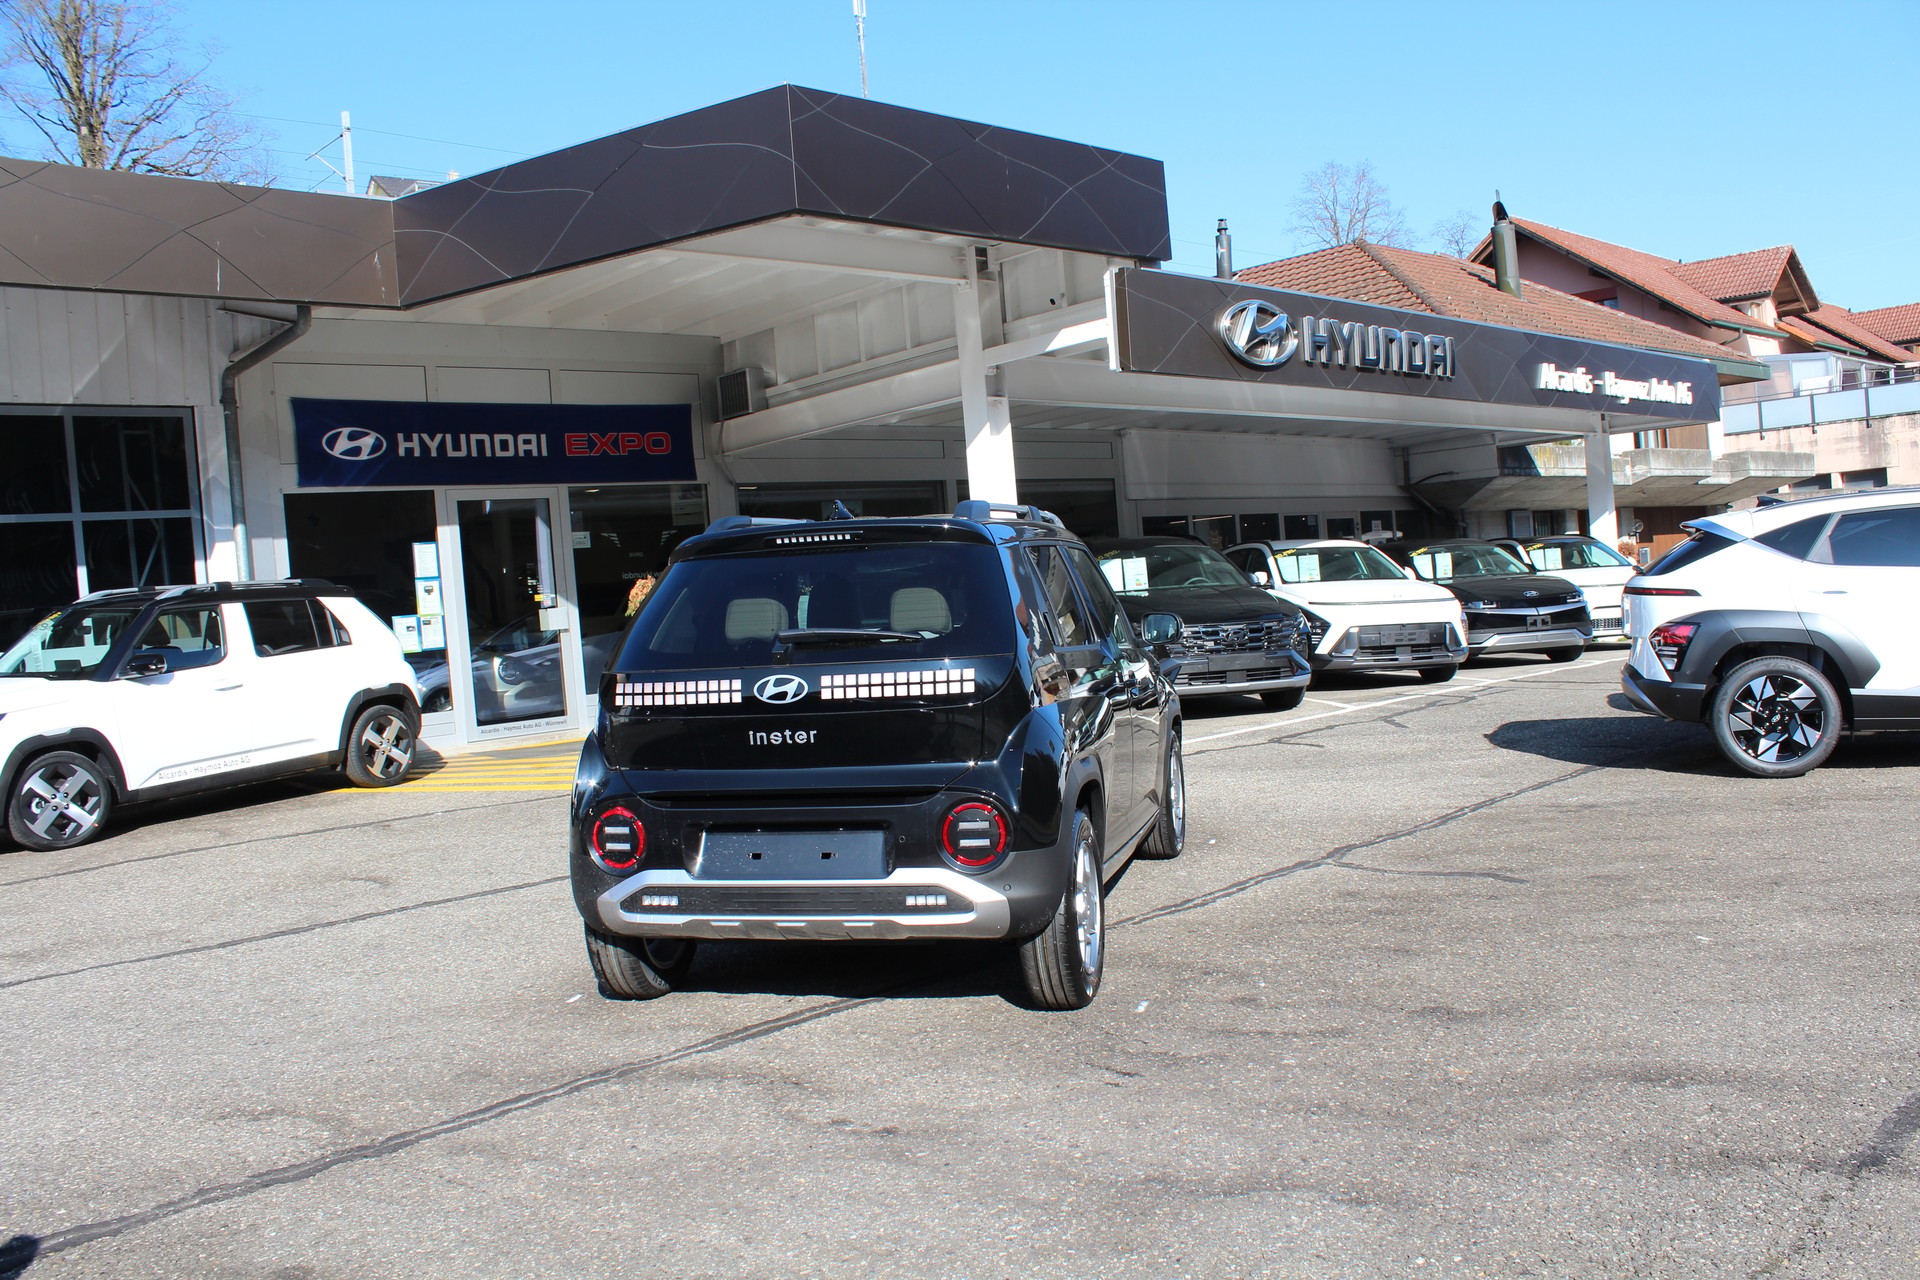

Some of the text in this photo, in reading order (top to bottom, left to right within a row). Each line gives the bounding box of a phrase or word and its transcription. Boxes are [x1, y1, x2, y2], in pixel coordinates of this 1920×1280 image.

[1303, 316, 1455, 378] HYUNDAI
[398, 431, 672, 457] HYUNDAI EXPO
[749, 729, 817, 745] inster
[158, 770, 188, 780] Alcardis
[193, 763, 221, 774] Haymoz
[223, 759, 239, 767] Auto
[240, 755, 251, 763] AG
